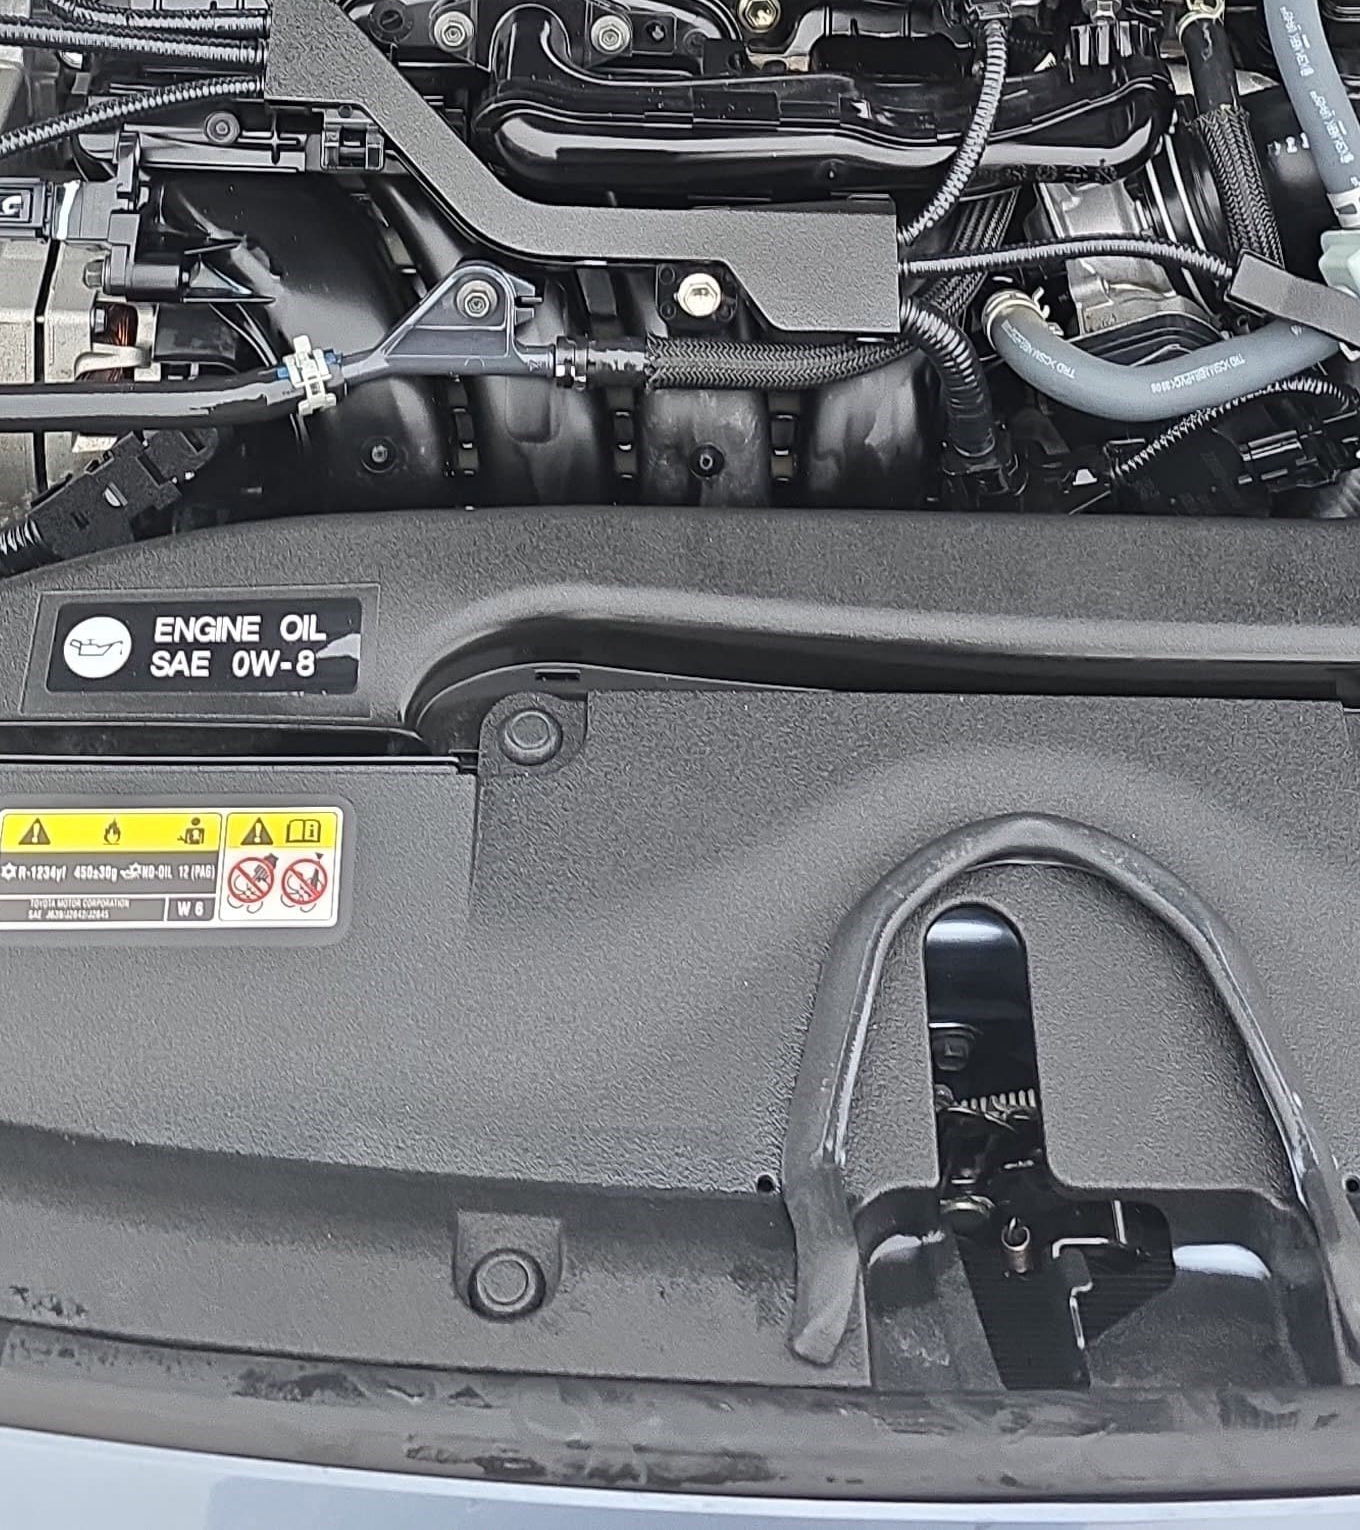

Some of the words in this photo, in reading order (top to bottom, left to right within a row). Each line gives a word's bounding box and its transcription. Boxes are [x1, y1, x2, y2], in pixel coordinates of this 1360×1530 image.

[154, 615, 262, 644] ENGINE
[279, 614, 327, 643] OIL
[150, 649, 211, 678] SAE
[232, 649, 316, 678] 0W-8
[178, 864, 189, 880] 12
[191, 864, 216, 881] (PAG)
[30, 898, 56, 909] TOYOTA
[177, 901, 192, 916] W
